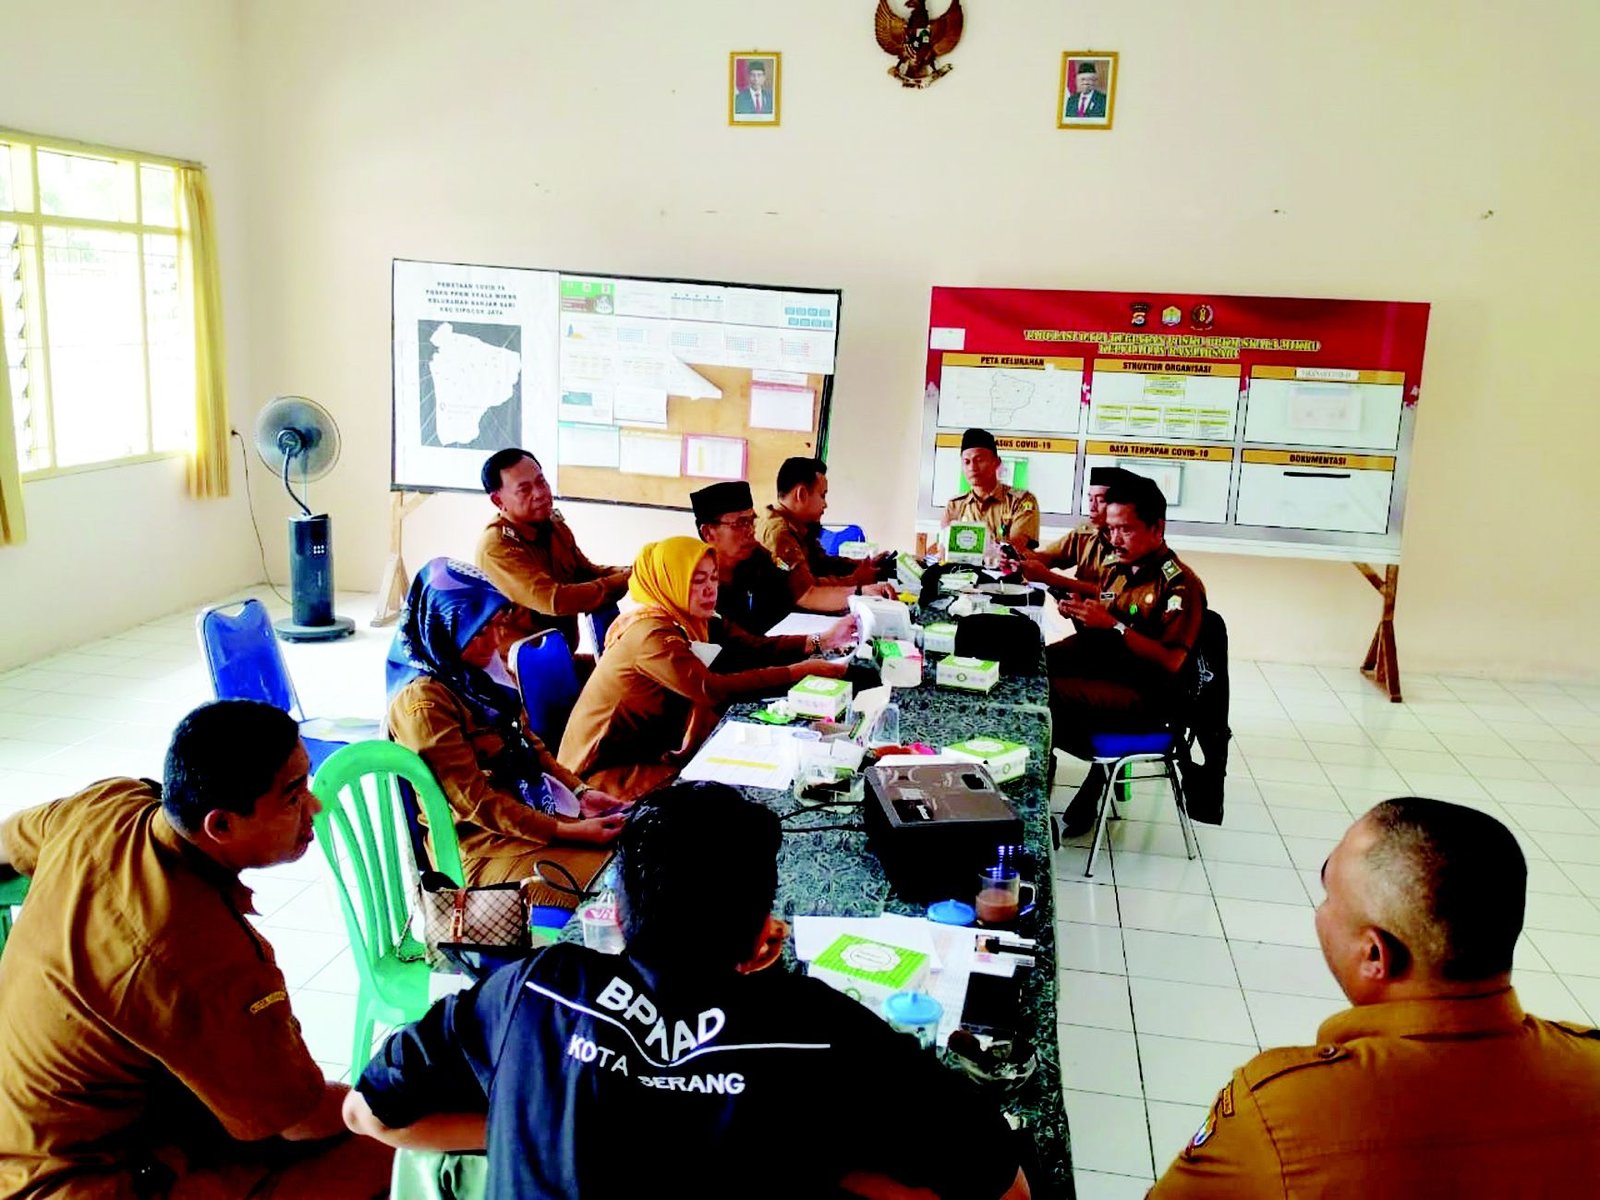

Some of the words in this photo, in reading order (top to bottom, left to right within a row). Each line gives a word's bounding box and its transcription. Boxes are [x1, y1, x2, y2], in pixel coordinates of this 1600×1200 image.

[980, 356, 999, 364] PETA
[1001, 357, 1045, 366] KELURAHAN
[1122, 361, 1163, 371] STRUKTUR
[1164, 363, 1212, 373] ORGANISASI
[994, 439, 1014, 448] ASUS
[1015, 440, 1051, 449] COVID-19
[1109, 444, 1129, 453] DATA
[1131, 446, 1169, 455] TERPAPAR
[1171, 448, 1209, 458] COVID-19
[1289, 454, 1347, 465] DOKUMENTASI
[567, 1033, 629, 1077] KOTA
[637, 1072, 746, 1095] SERANG
